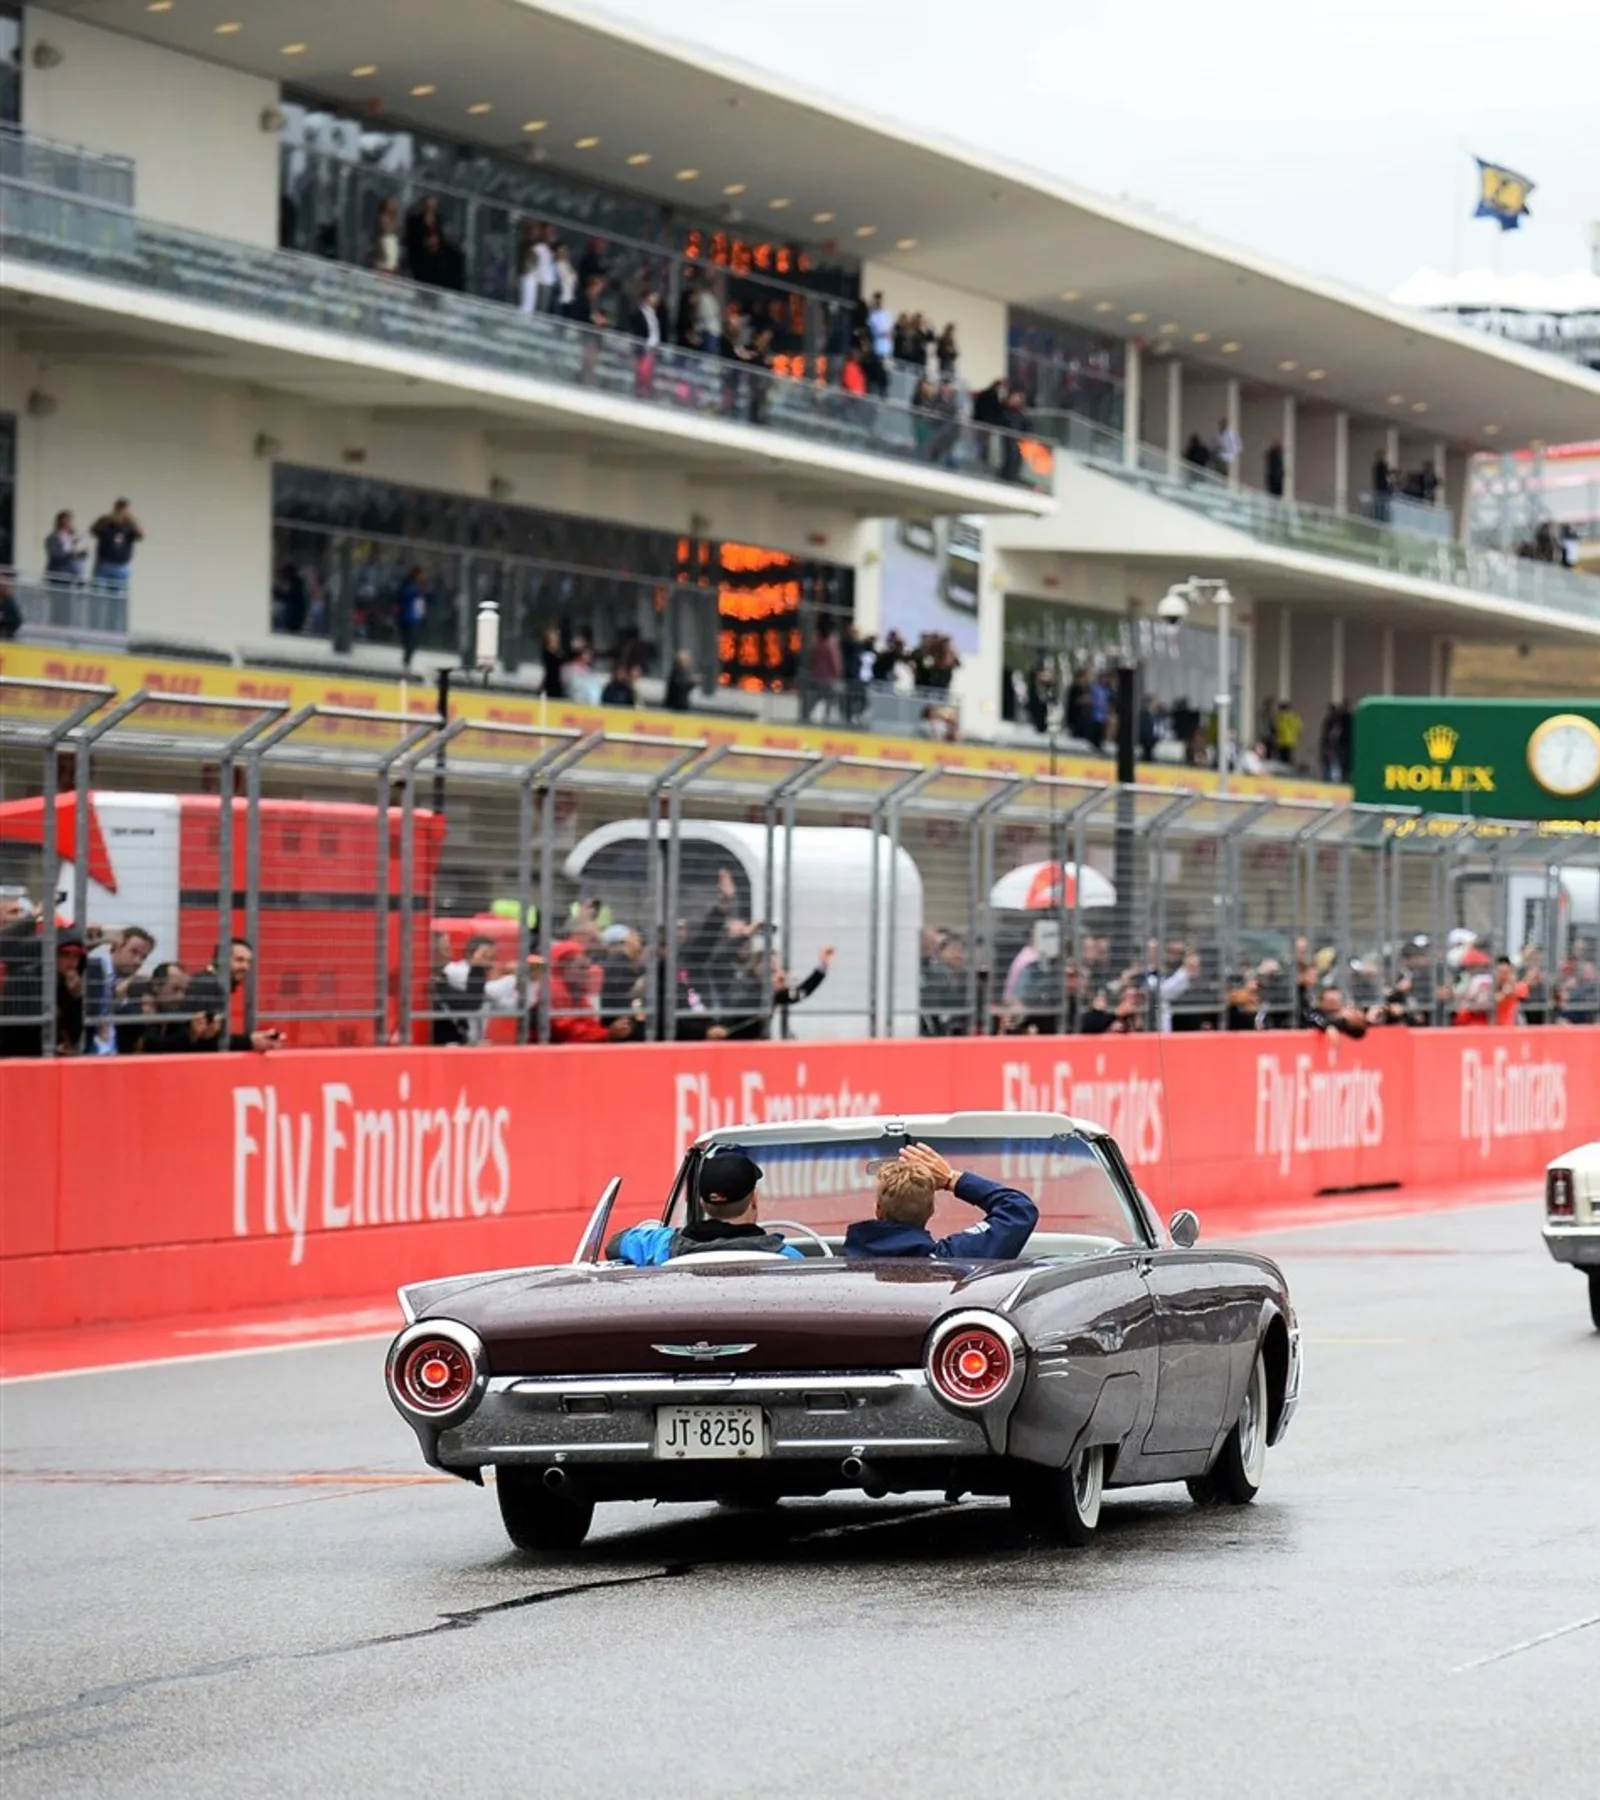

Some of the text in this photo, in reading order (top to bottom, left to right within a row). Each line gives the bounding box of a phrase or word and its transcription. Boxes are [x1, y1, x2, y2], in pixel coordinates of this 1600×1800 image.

[1384, 766, 1496, 792] ROLEX
[1256, 1047, 1383, 1178] Fly Emirates
[1459, 1047, 1493, 1159] Fly
[1492, 1041, 1566, 1138] Emirates
[232, 1071, 510, 1266] Fly Emirates
[684, 1409, 735, 1417] TEXAS
